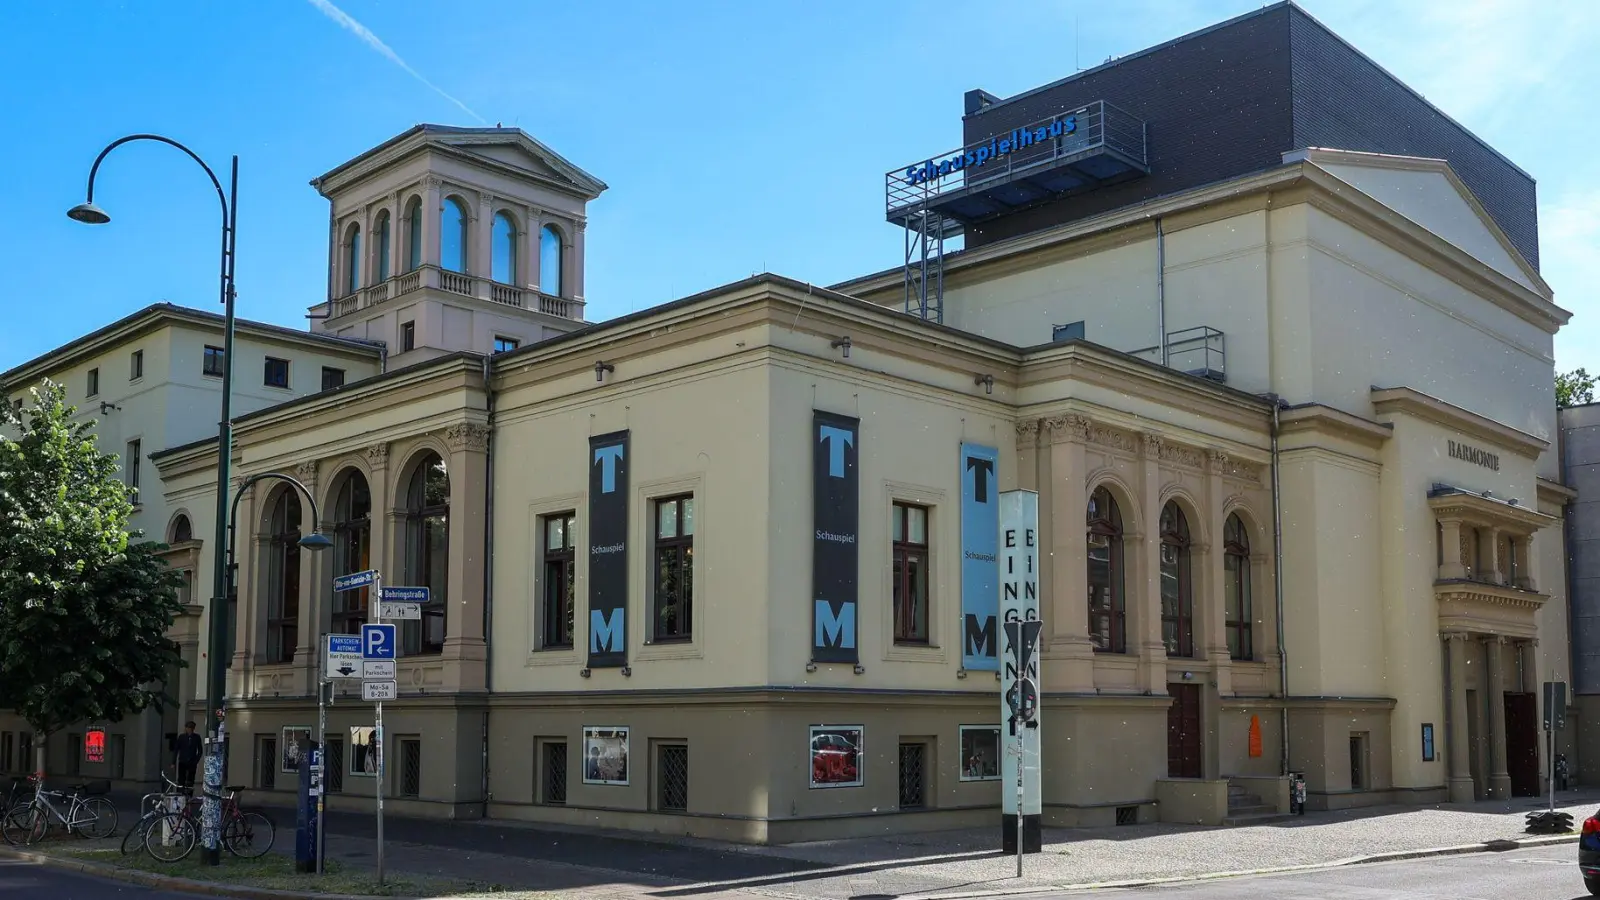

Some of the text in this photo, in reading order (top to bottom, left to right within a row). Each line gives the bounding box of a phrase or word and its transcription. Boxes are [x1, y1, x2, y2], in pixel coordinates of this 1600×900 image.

[906, 116, 1077, 185] Schauspielhaus
[594, 443, 624, 494] T
[820, 424, 853, 478] T
[1447, 439, 1500, 471] HARMONIE
[967, 456, 994, 503] T
[591, 541, 625, 555] Schauspiel
[816, 529, 855, 544] Schauspiel
[965, 550, 996, 563] Schauspiel
[384, 589, 425, 600] Behringstraße
[367, 629, 385, 655] P
[590, 607, 624, 653] M
[816, 600, 855, 648] M
[965, 613, 996, 657] M
